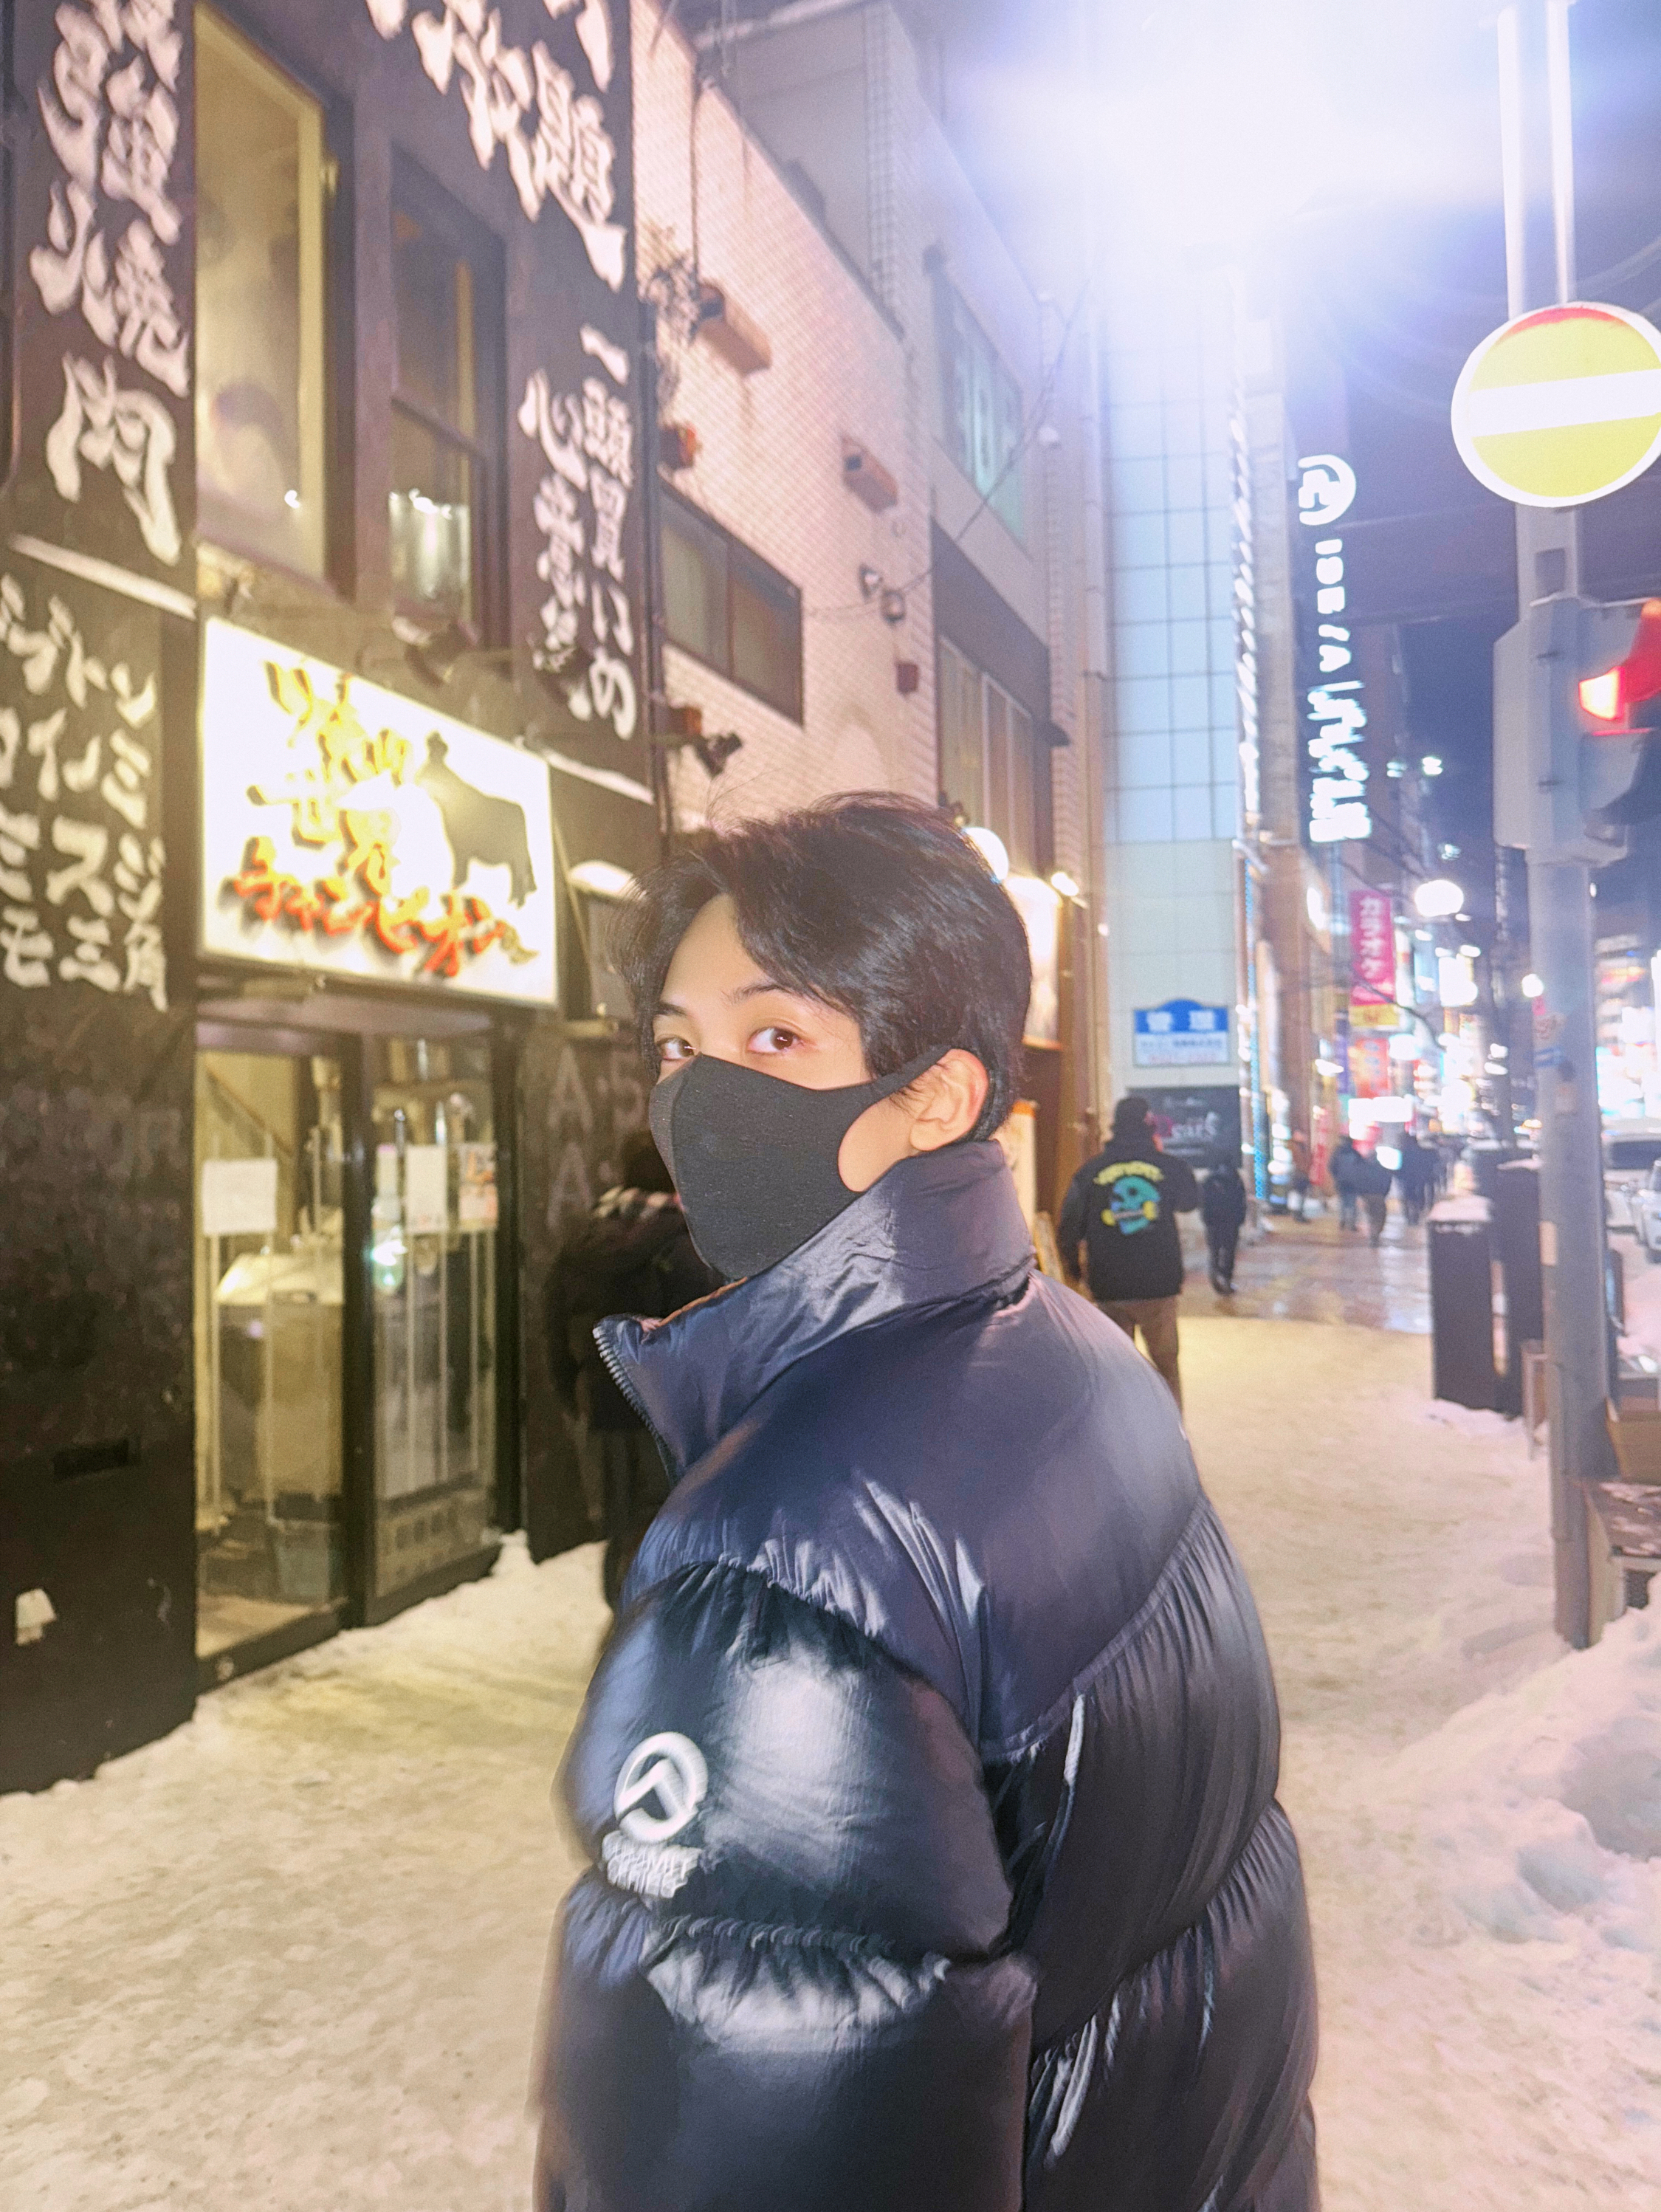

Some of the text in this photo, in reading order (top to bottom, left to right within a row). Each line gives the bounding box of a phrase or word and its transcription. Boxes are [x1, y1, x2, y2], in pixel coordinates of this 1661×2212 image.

[580, 323, 636, 741] 一頭買いの
